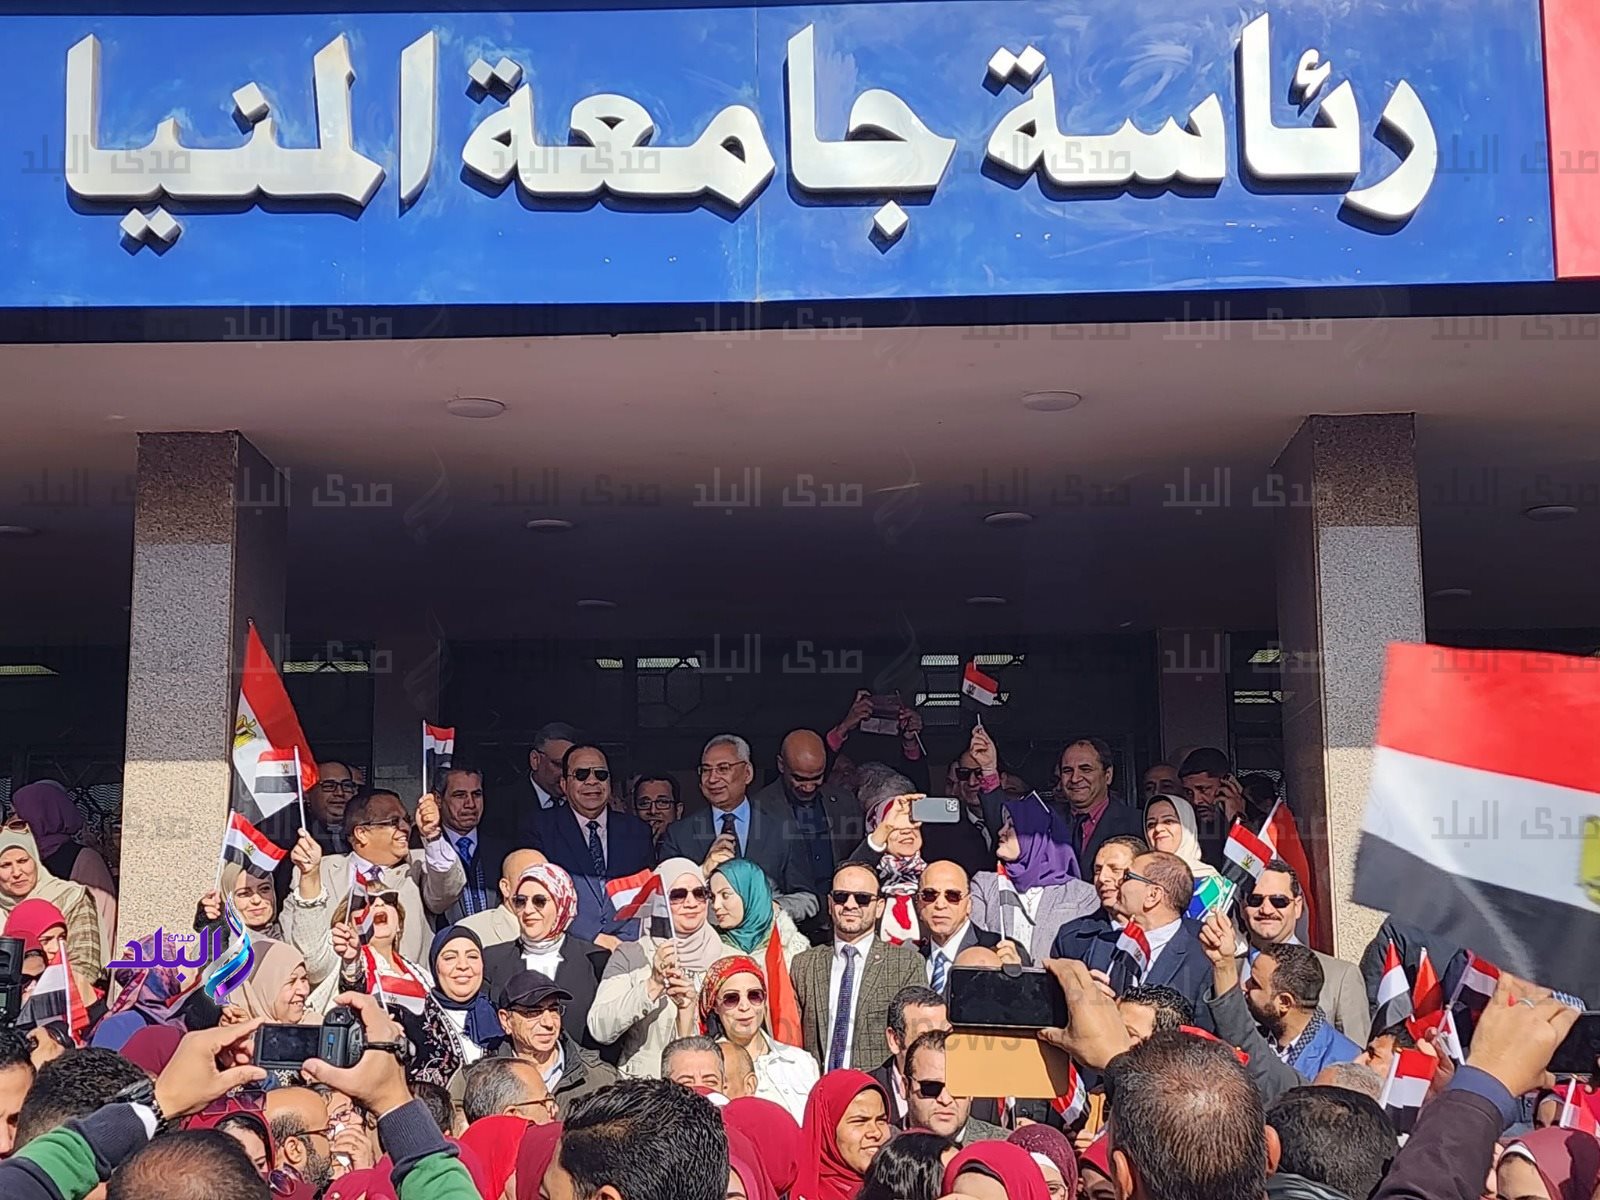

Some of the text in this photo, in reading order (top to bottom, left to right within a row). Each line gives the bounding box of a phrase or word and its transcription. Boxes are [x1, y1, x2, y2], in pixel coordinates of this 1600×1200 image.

[65, 11, 1438, 248] رئاسة جامعة المنيا
